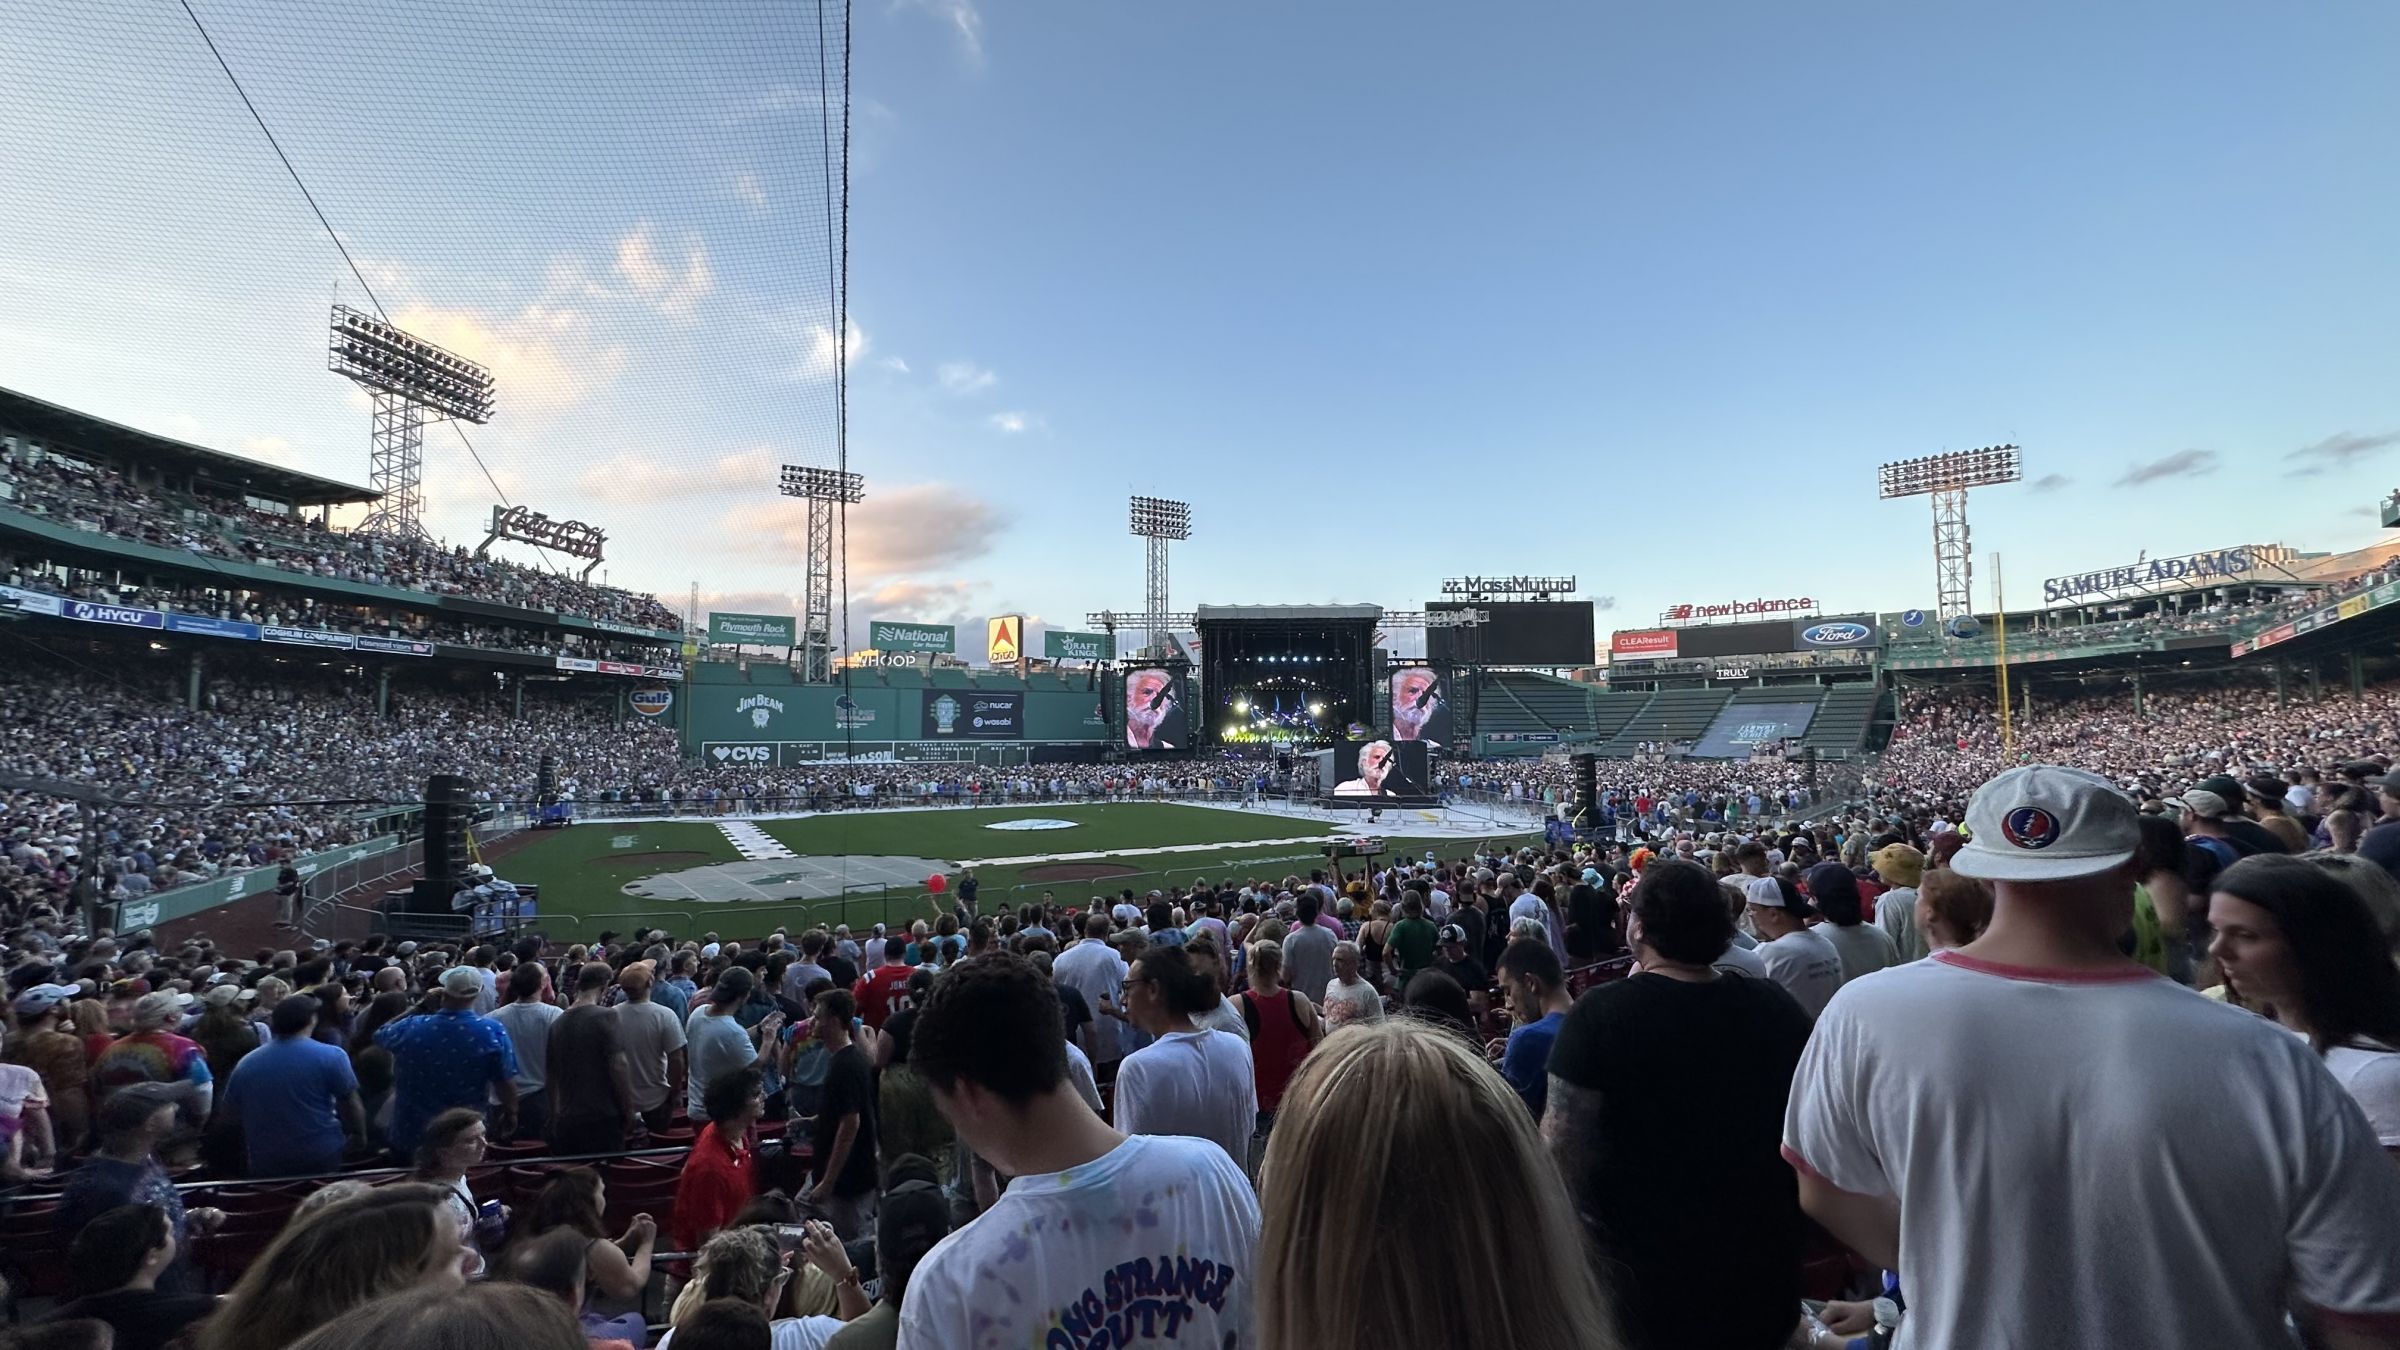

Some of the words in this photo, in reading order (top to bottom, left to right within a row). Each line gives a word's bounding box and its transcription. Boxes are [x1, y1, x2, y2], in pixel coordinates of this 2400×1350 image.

[500, 506, 604, 559] Coca-Cola
[2044, 566, 2143, 602] SAMUEL
[2145, 548, 2248, 581] ADAMS
[1465, 575, 1576, 592] MassMutual
[1696, 604, 1731, 617] new
[1733, 597, 1812, 614] balance
[98, 608, 142, 623] HYCU
[264, 627, 303, 639] COGHLIN
[720, 621, 762, 632] Plymouth
[763, 623, 786, 633] Rock
[1816, 623, 1856, 641] Ford
[894, 629, 949, 643] National
[1620, 635, 1670, 646] CLEAResult
[1062, 642, 1099, 651] DRAFT
[858, 655, 916, 667] WHOOP
[991, 650, 1015, 661] CITGO
[1716, 669, 1749, 678] TRULY
[631, 692, 669, 703] Gulf
[736, 697, 756, 713] JIM
[756, 694, 784, 714] BEAM
[984, 717, 1012, 726] wasabi
[731, 746, 770, 761] CVS
[1046, 1287, 1103, 1350] ONG
[1103, 1255, 1235, 1314] STRANGE
